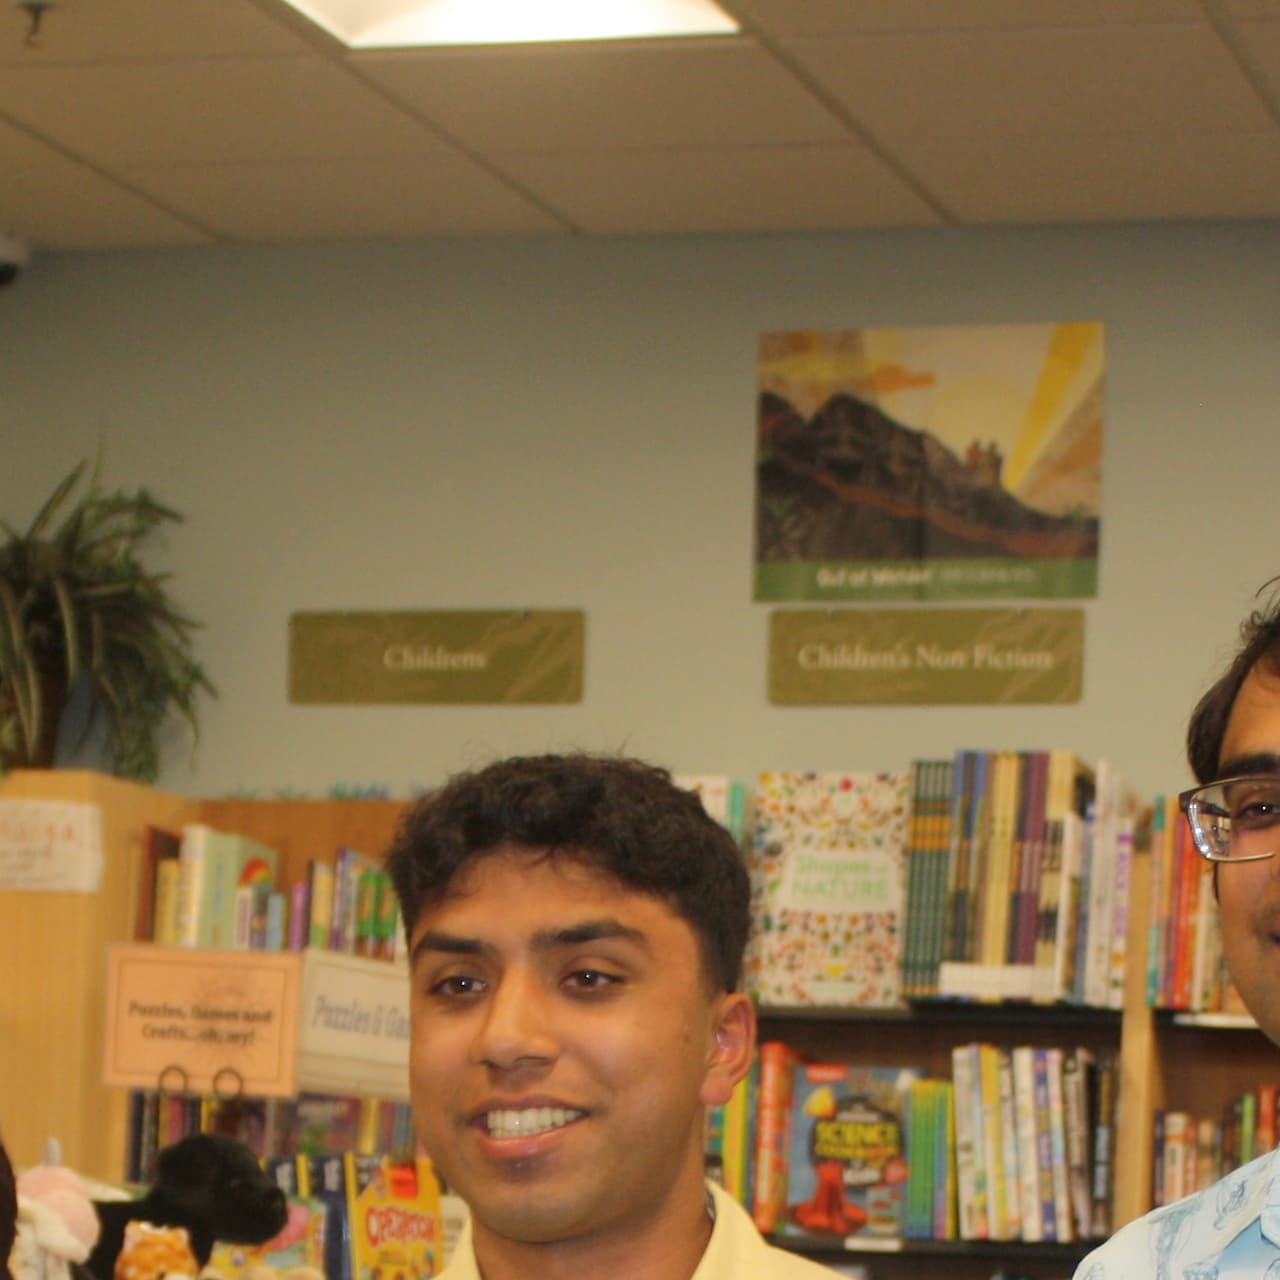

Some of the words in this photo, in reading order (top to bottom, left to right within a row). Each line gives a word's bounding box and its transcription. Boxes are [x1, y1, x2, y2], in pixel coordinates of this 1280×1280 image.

[797, 641, 910, 671] Children's
[915, 643, 969, 671] Non
[974, 643, 1055, 671] Fiction
[242, 1007, 273, 1023] and
[313, 993, 371, 1034] Puzzles
